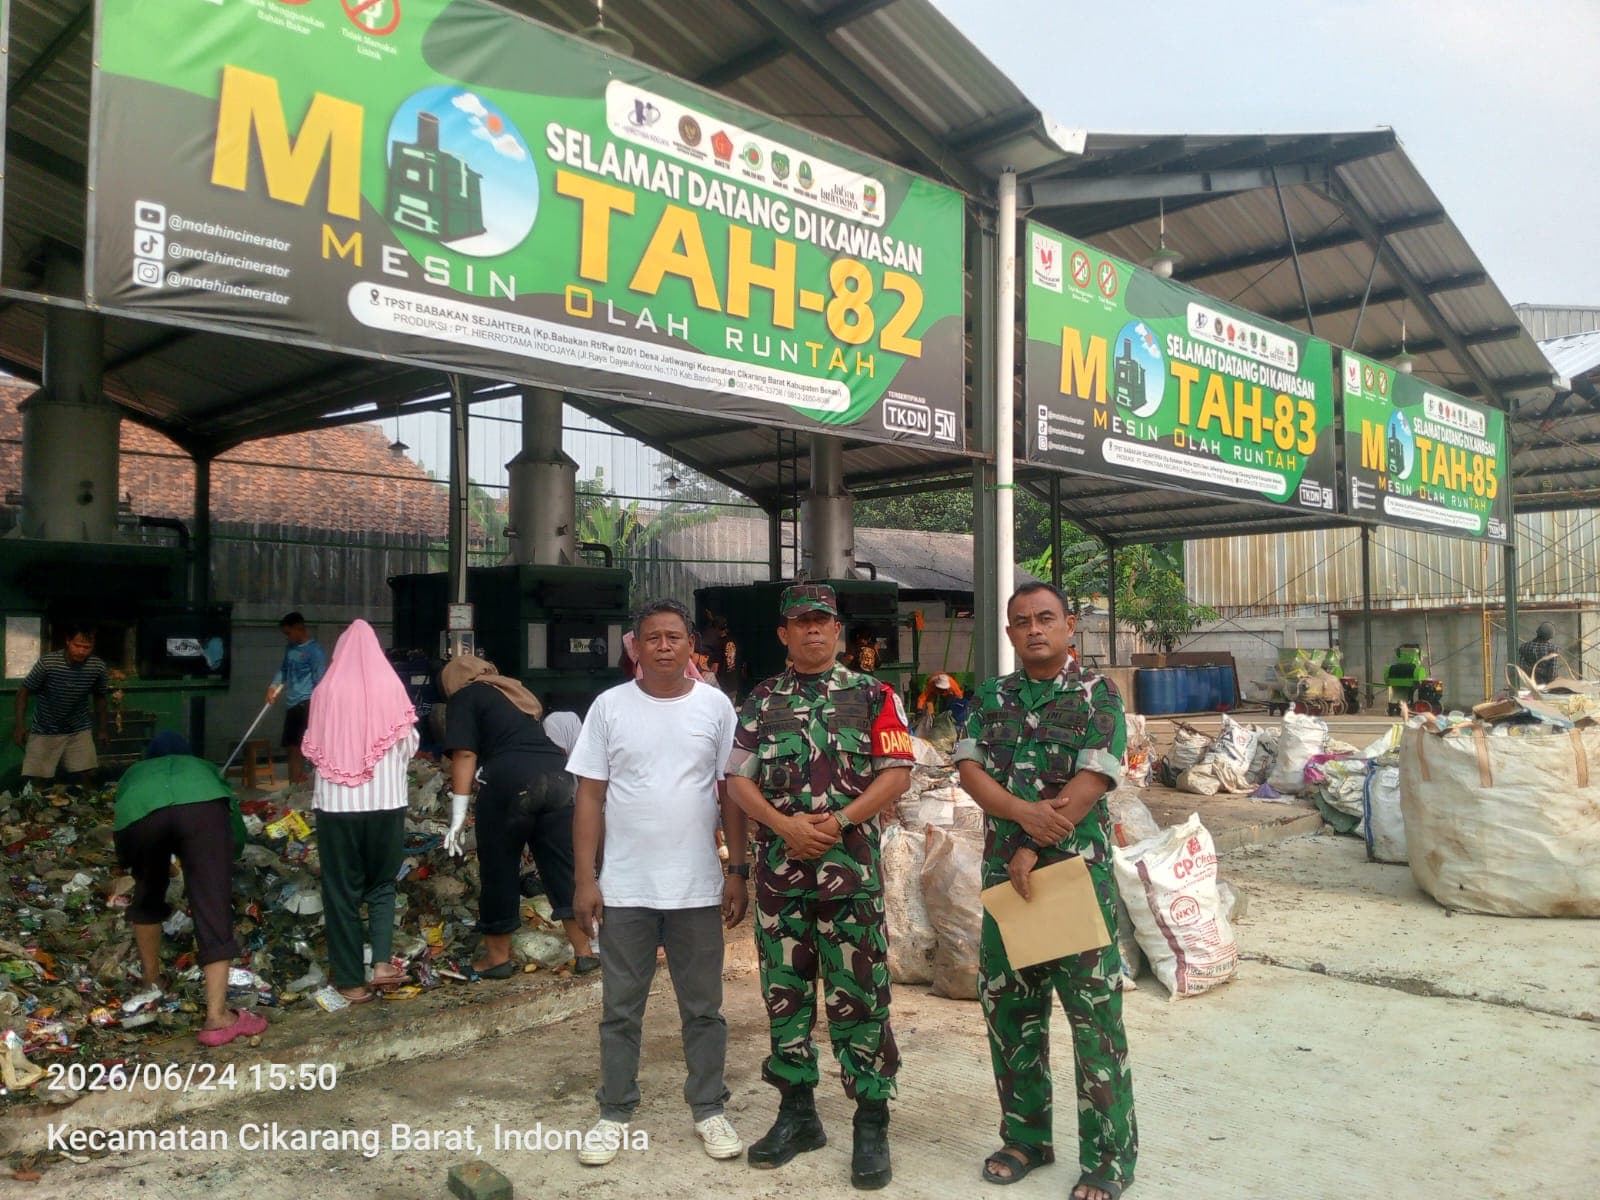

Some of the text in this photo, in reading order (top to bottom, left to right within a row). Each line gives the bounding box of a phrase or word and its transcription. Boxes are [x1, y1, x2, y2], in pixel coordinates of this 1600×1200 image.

[545, 121, 686, 197] SELAMAT
[687, 170, 791, 235] DATANG
[820, 216, 923, 276] KAWASAN
[168, 214, 291, 253] @motahincinerator
[168, 241, 291, 279] @motahincinerator
[167, 271, 290, 306] @motahincinerator
[321, 223, 875, 379] MESIN OLAH RUNTAH
[384, 297, 413, 311] TPST
[415, 303, 469, 323] BABAKAN
[471, 314, 531, 335] SEJAHTERA
[533, 328, 589, 348] (Kp.Babakan
[616, 344, 637, 356] 02/01
[639, 349, 659, 361] Desa
[660, 355, 696, 370] Jatiwangi
[697, 361, 736, 376] Kecamatan
[737, 369, 767, 384] Cikarang
[767, 375, 785, 387] Barat
[393, 313, 448, 332] PRODUKSI
[471, 329, 533, 349] HIERROTAMA
[534, 341, 577, 358] INDOJAYA
[1166, 333, 1217, 370] SELAMAT
[1217, 351, 1259, 381] DATANG
[887, 406, 927, 430] TKDN
[1093, 407, 1159, 442] MESIN
[1173, 428, 1221, 455] OLAH
[1234, 445, 1297, 472] RUNTAH
[1378, 475, 1413, 497] MESIN
[1419, 485, 1446, 505] OLAH
[1451, 495, 1487, 513] RUNTAH
[1173, 858, 1194, 879] CP
[1175, 904, 1198, 921] NKV
